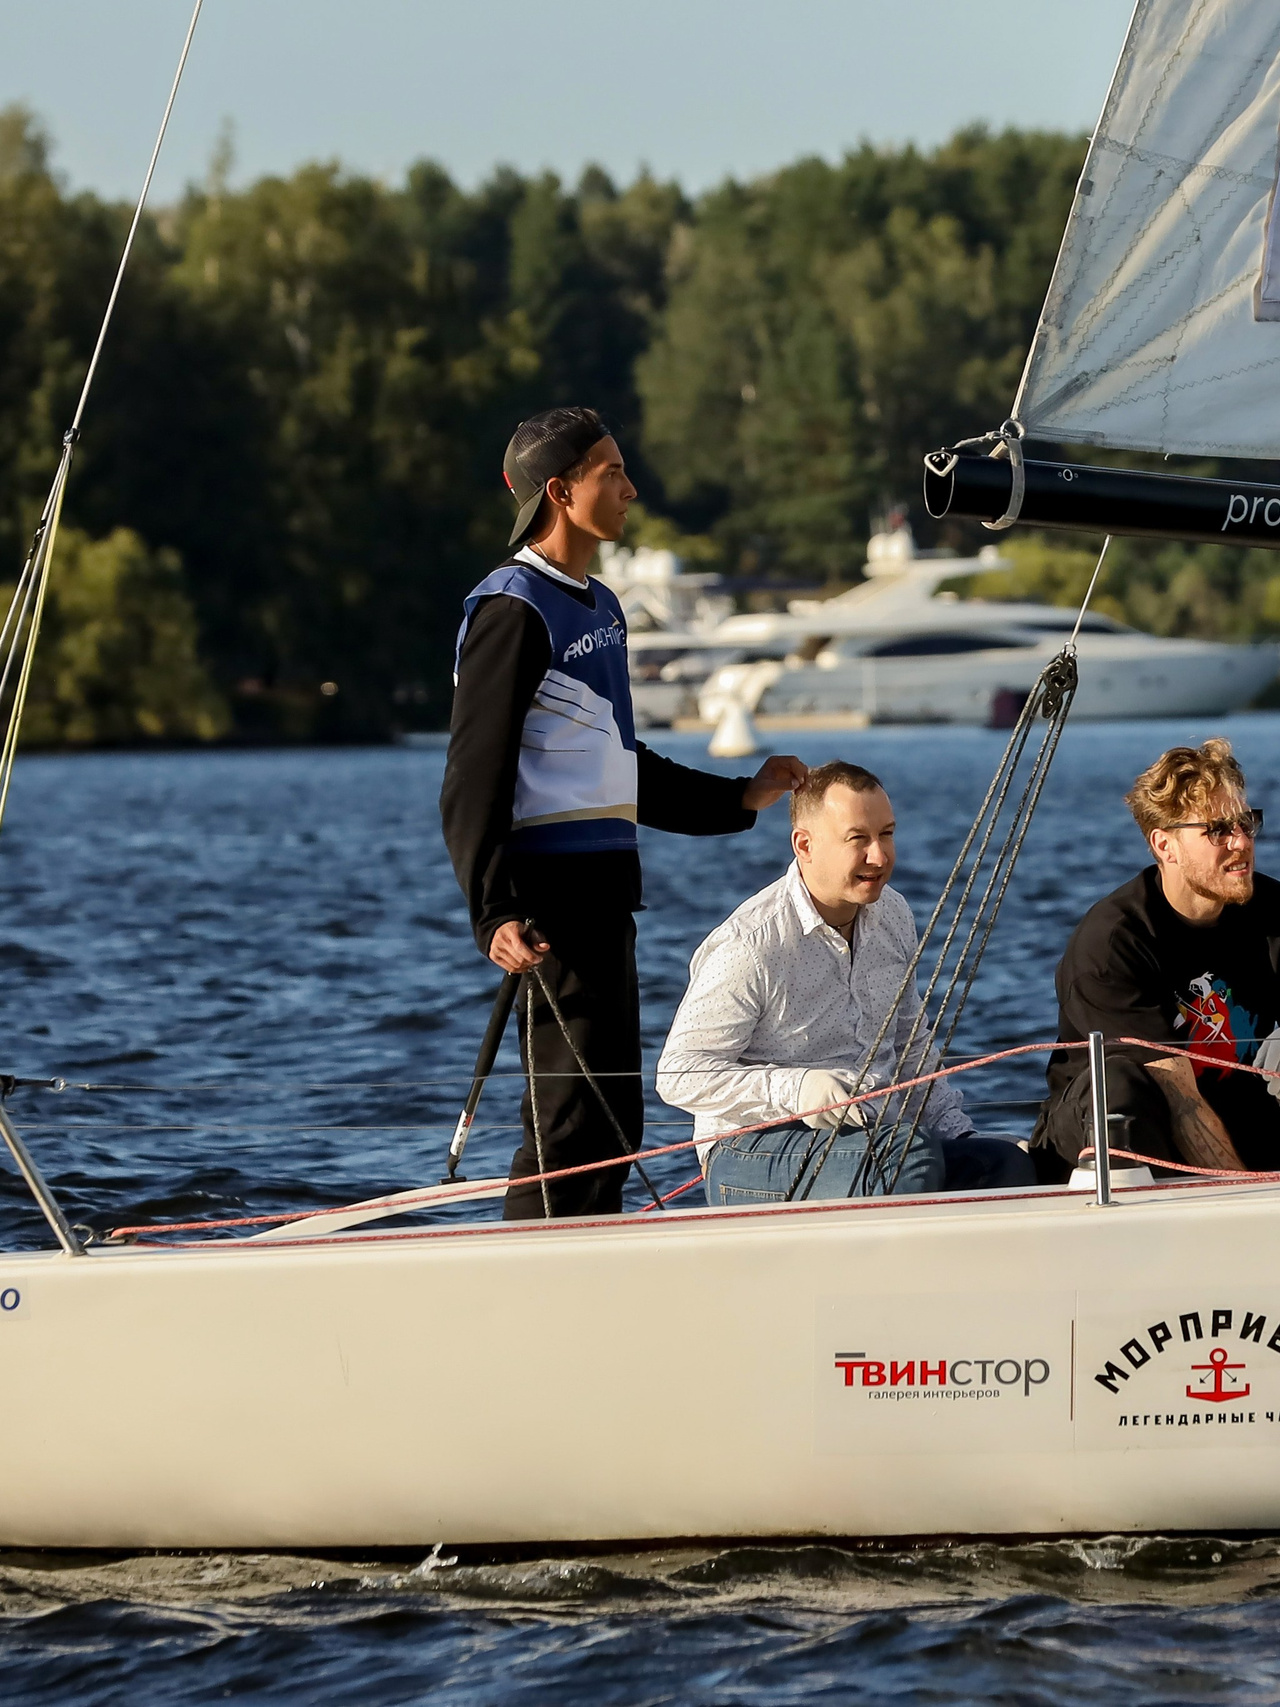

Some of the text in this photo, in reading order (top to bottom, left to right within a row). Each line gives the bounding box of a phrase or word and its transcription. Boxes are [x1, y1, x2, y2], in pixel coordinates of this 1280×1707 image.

[868, 1387, 1001, 1402] галерея интерьеров
[1118, 1411, 1256, 1427] ЛЕГЕНДАРНЫЕ
